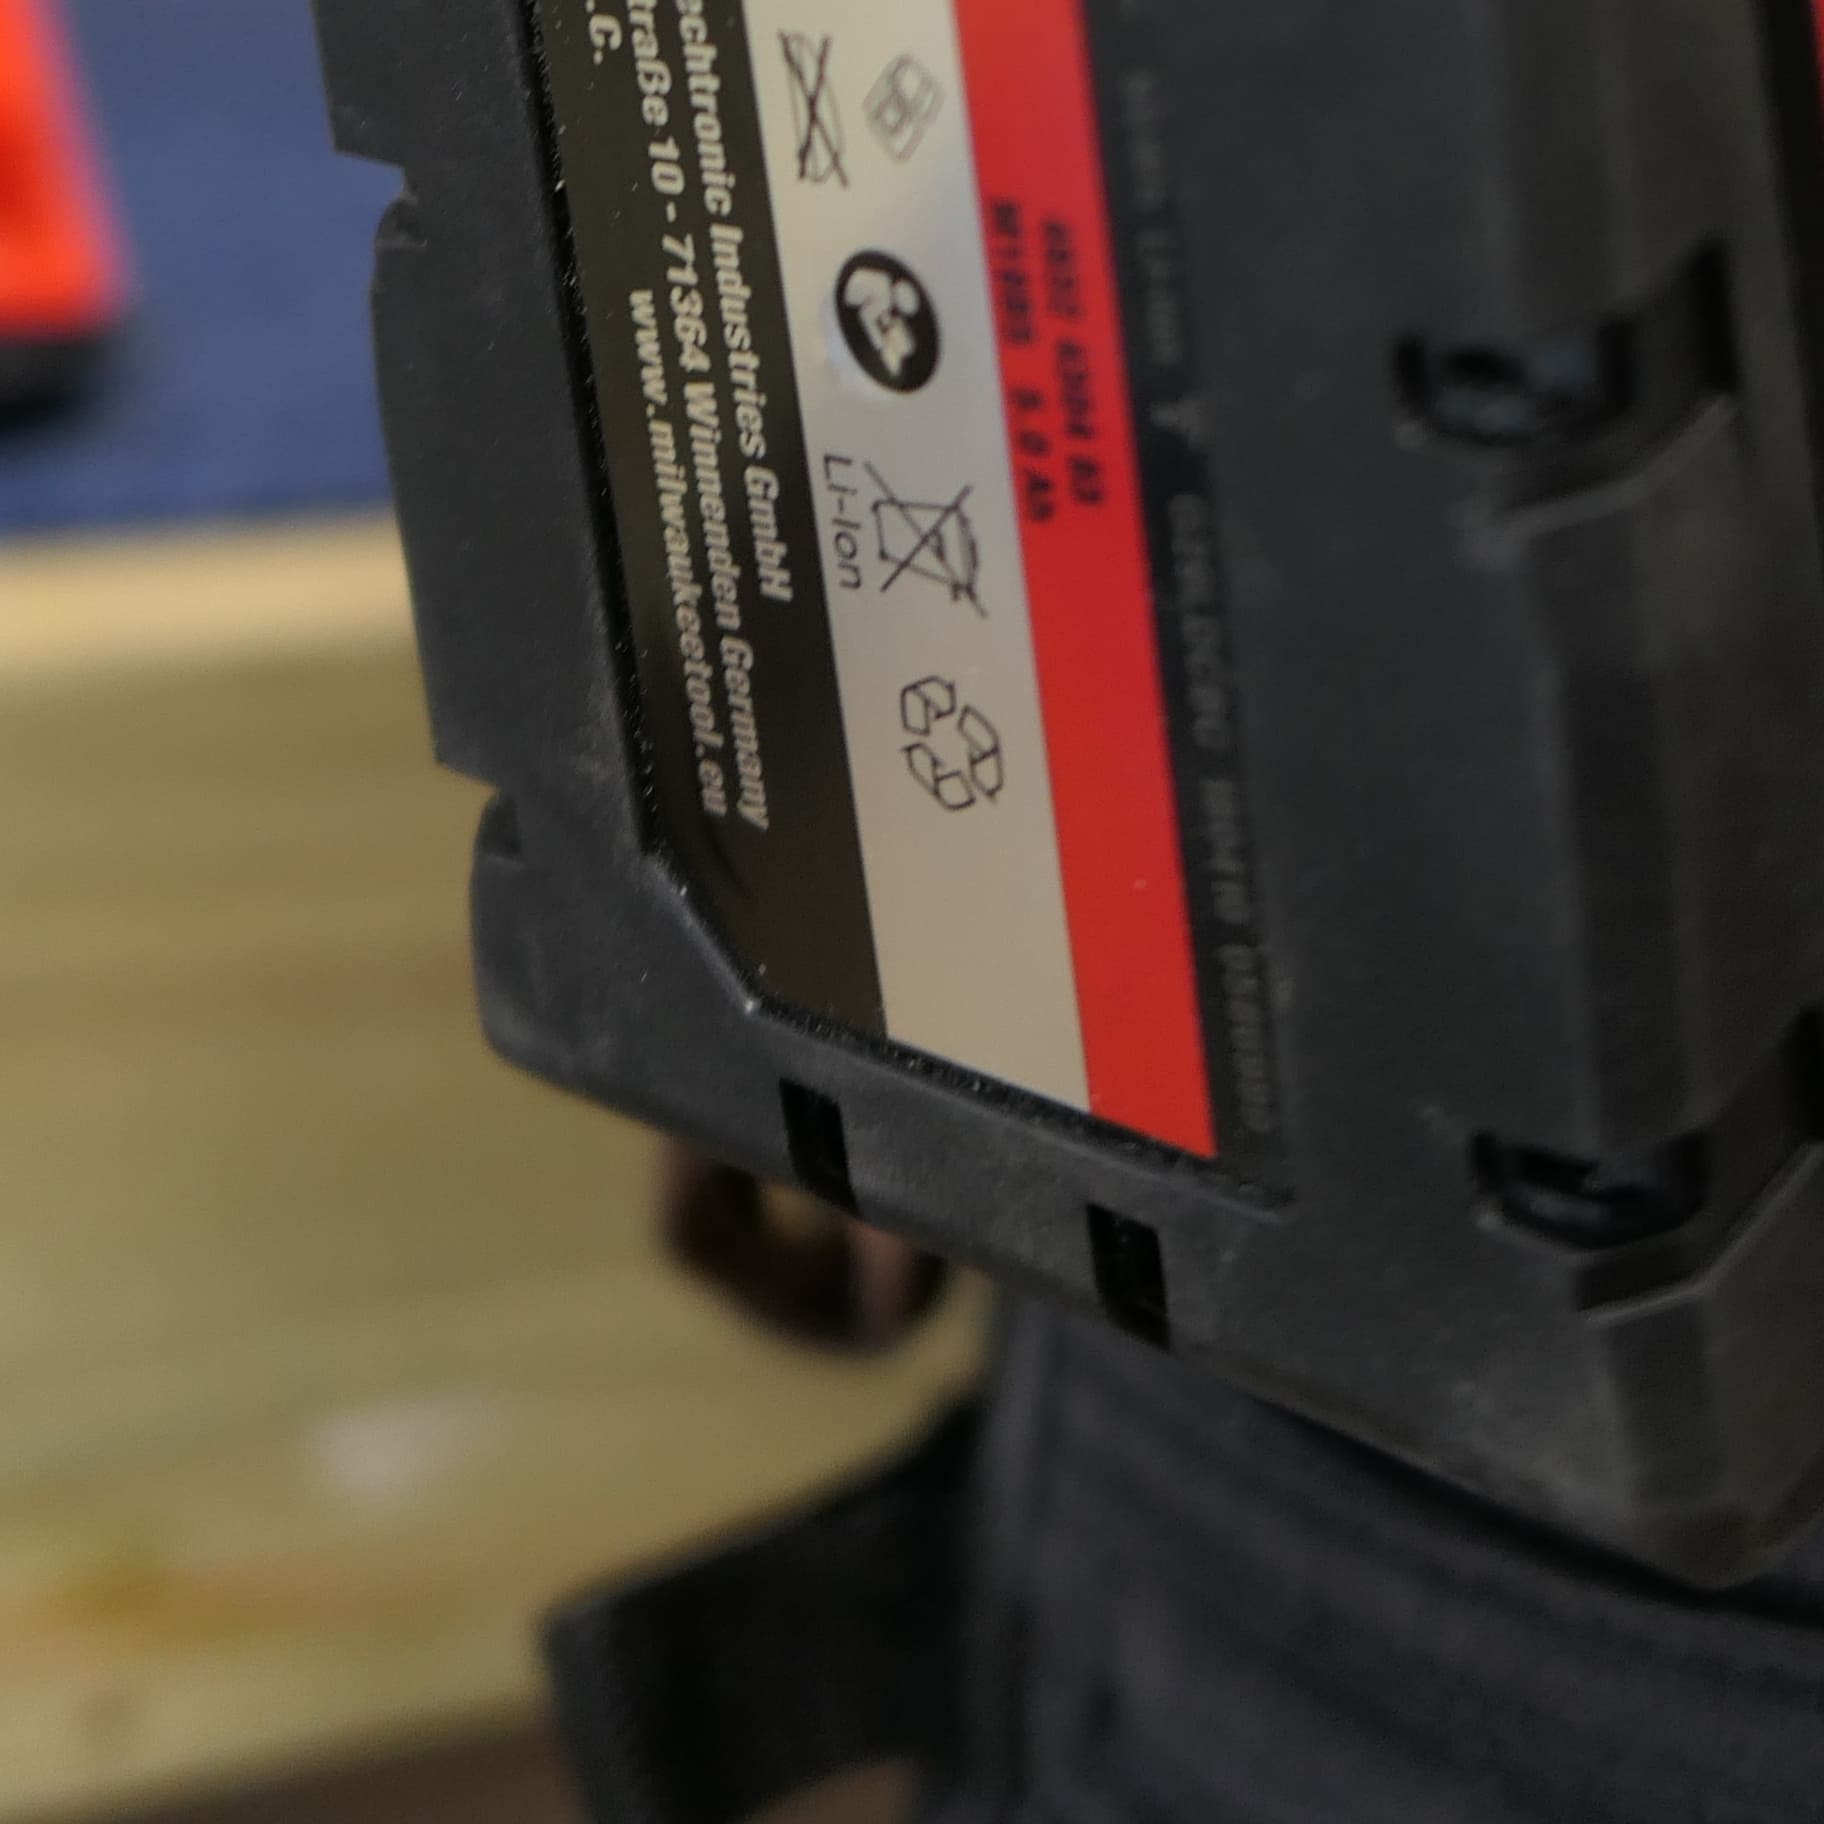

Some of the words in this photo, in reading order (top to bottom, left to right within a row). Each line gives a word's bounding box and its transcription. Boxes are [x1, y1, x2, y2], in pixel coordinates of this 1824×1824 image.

[647, 136, 685, 196] 10
[662, 233, 711, 373] 71364
[683, 382, 742, 631] Winnenden
[710, 223, 766, 459] Industries
[745, 465, 794, 602] GmbH
[629, 289, 727, 818] www.milwaukeetool.eu
[823, 453, 862, 591] Li-Ion
[719, 636, 769, 831] Germany
